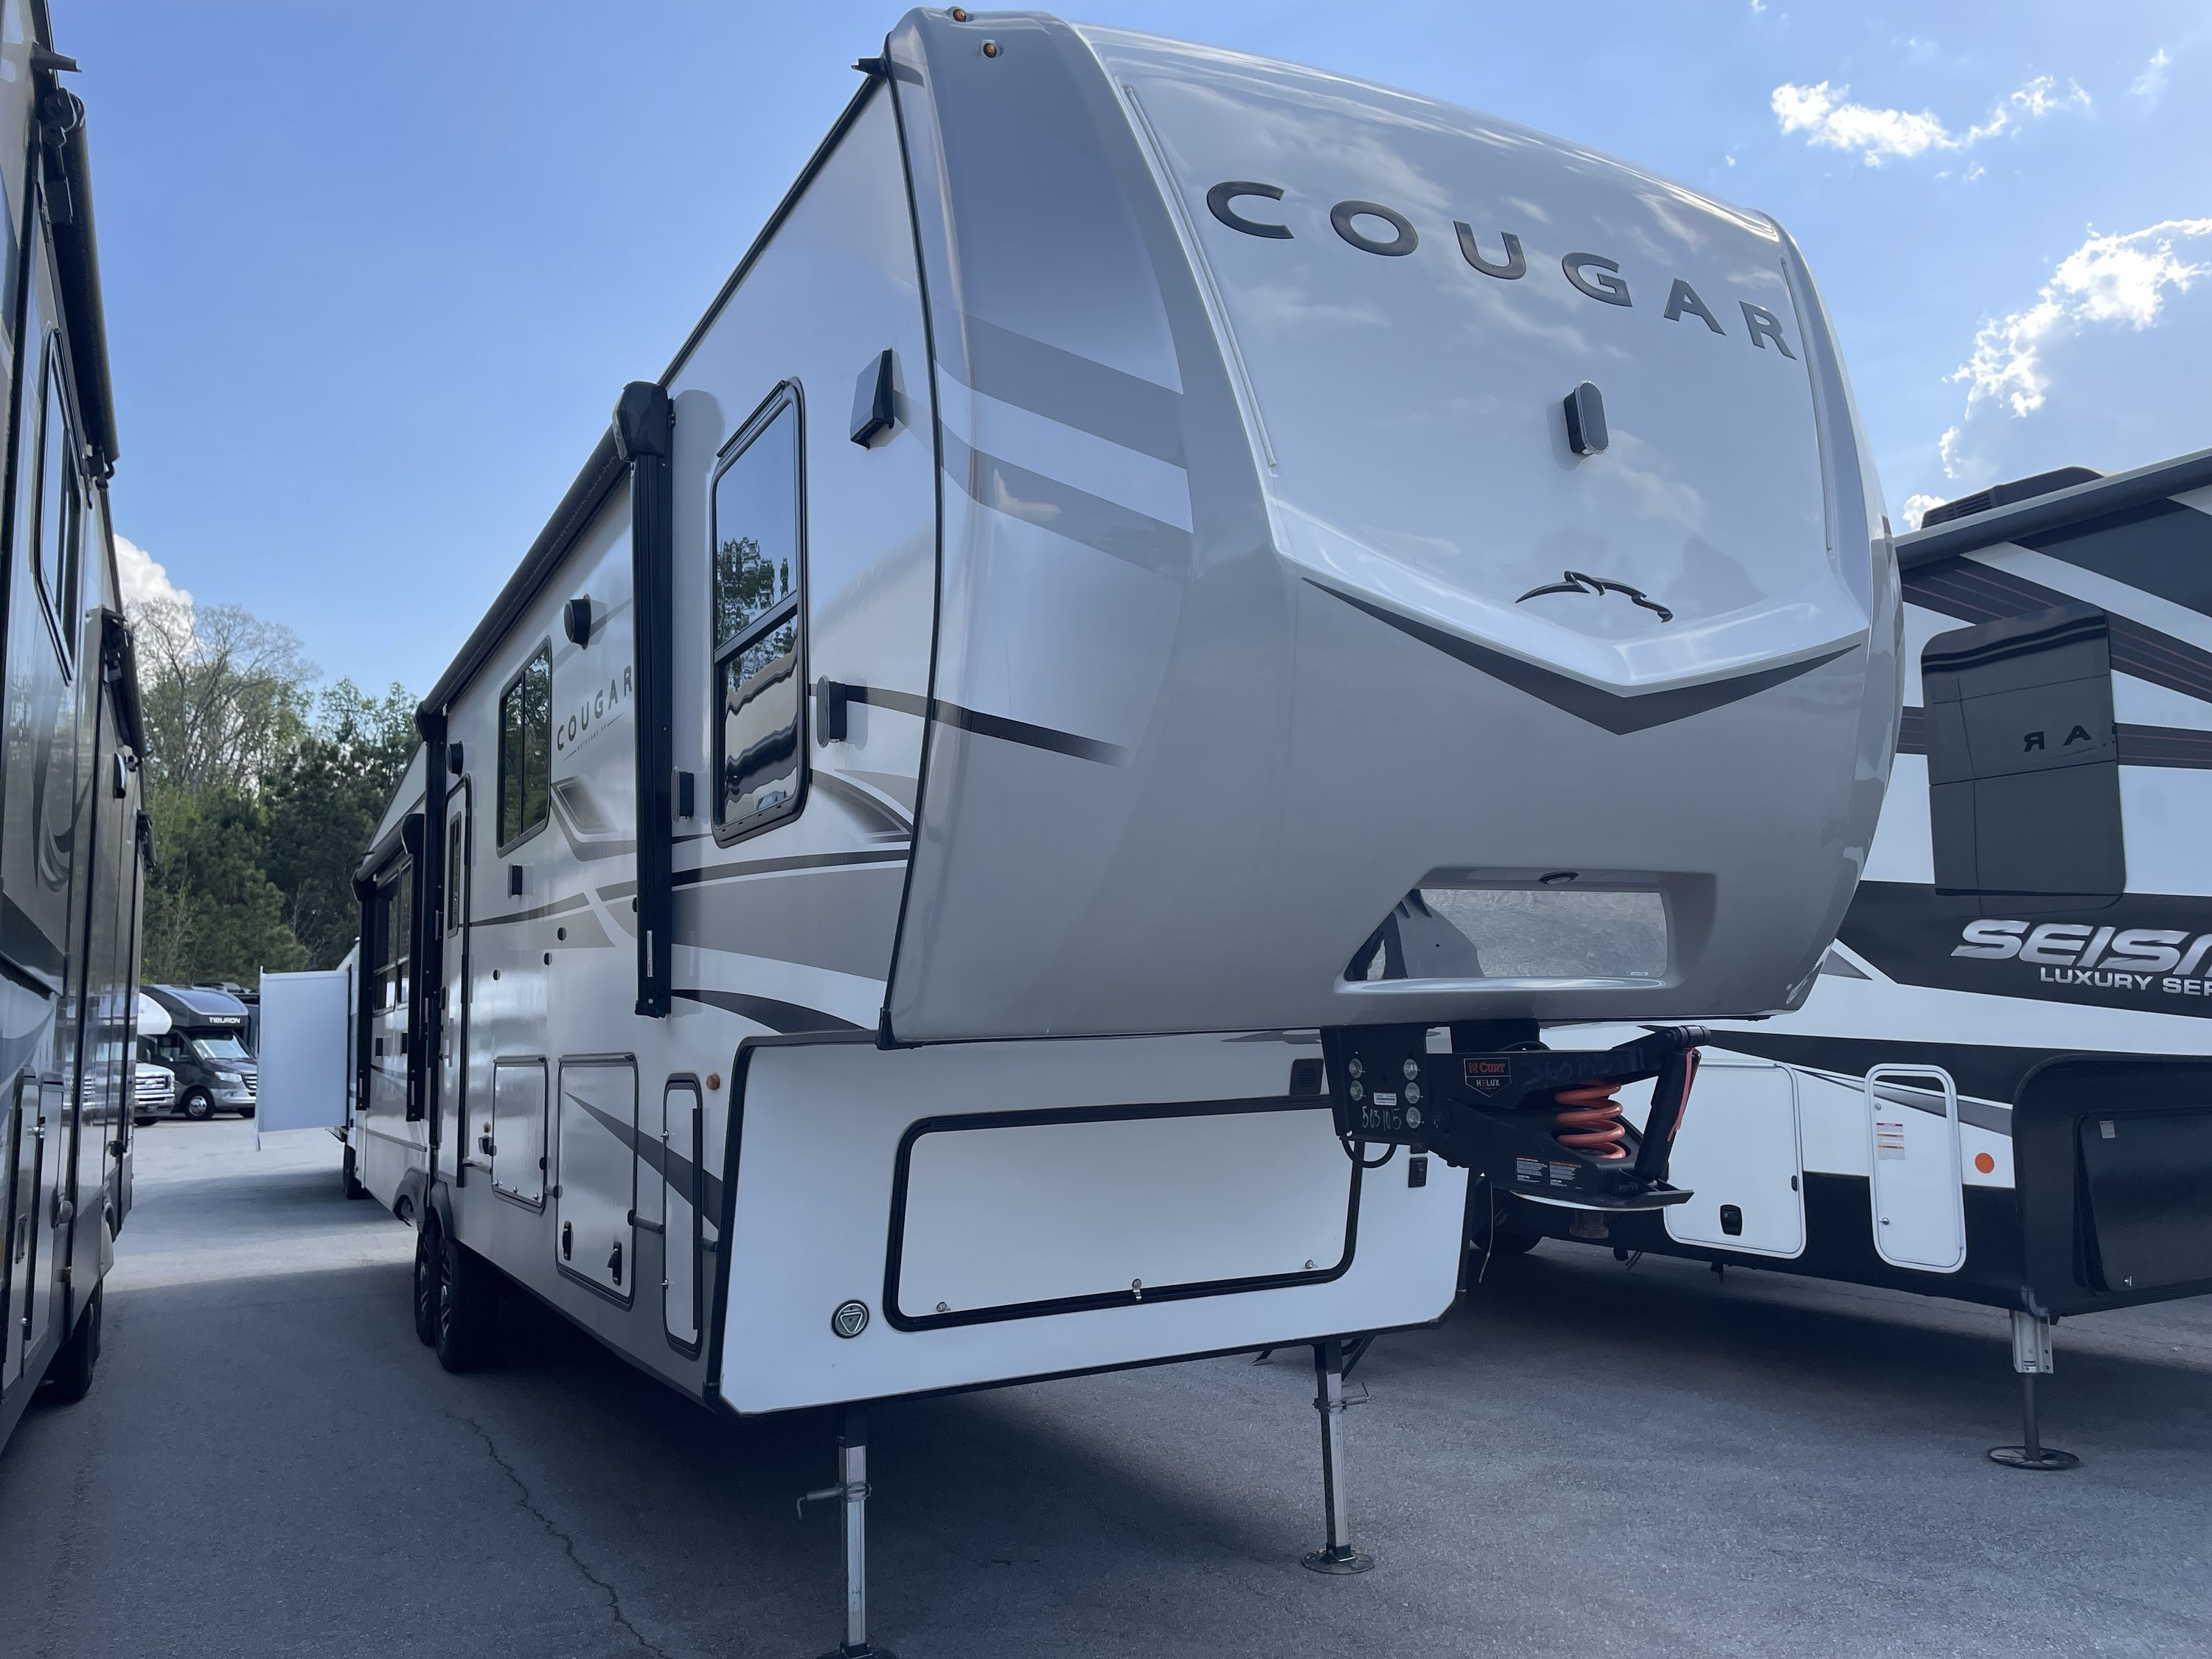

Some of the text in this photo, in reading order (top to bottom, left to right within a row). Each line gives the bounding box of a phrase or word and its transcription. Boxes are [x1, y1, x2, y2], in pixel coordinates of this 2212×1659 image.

[1206, 181, 1796, 360] COUGAR
[557, 665, 633, 751] COUGAR
[2039, 967, 2154, 990] LUXURY
[1479, 1062, 1505, 1073] CURT
[1362, 1105, 1402, 1131] 503105
